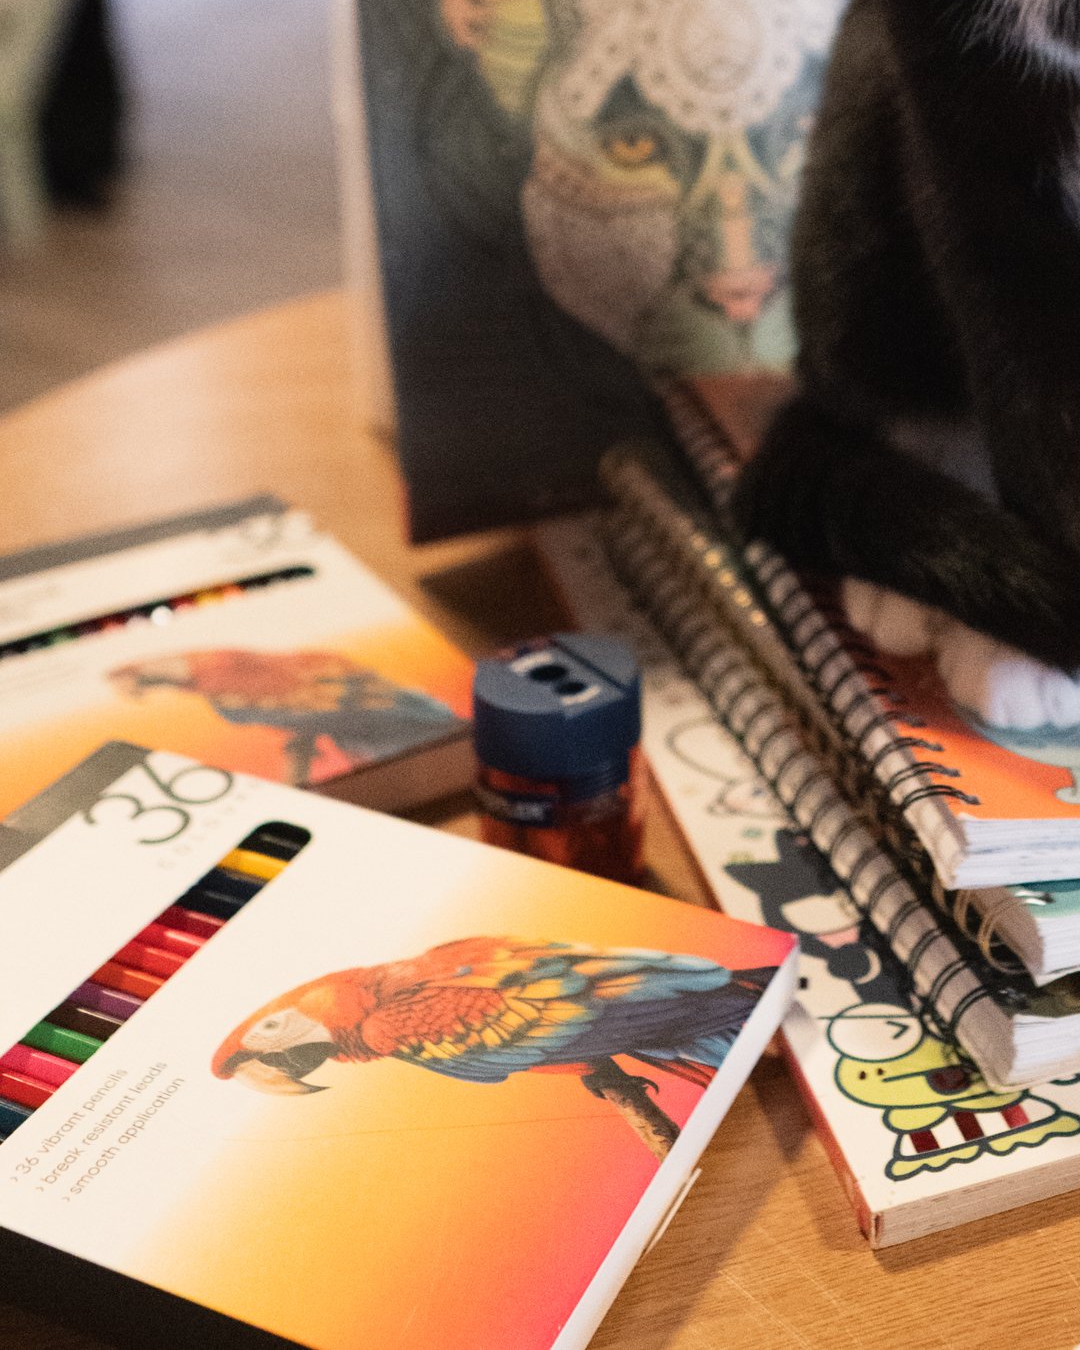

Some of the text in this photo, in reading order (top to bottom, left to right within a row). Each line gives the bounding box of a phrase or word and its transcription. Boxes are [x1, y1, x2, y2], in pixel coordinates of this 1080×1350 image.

[83, 760, 233, 844] 36
[15, 1068, 129, 1175] 36 vibrant pencils
[41, 1061, 168, 1185] break resistant leads
[70, 1076, 185, 1195] smooth application
